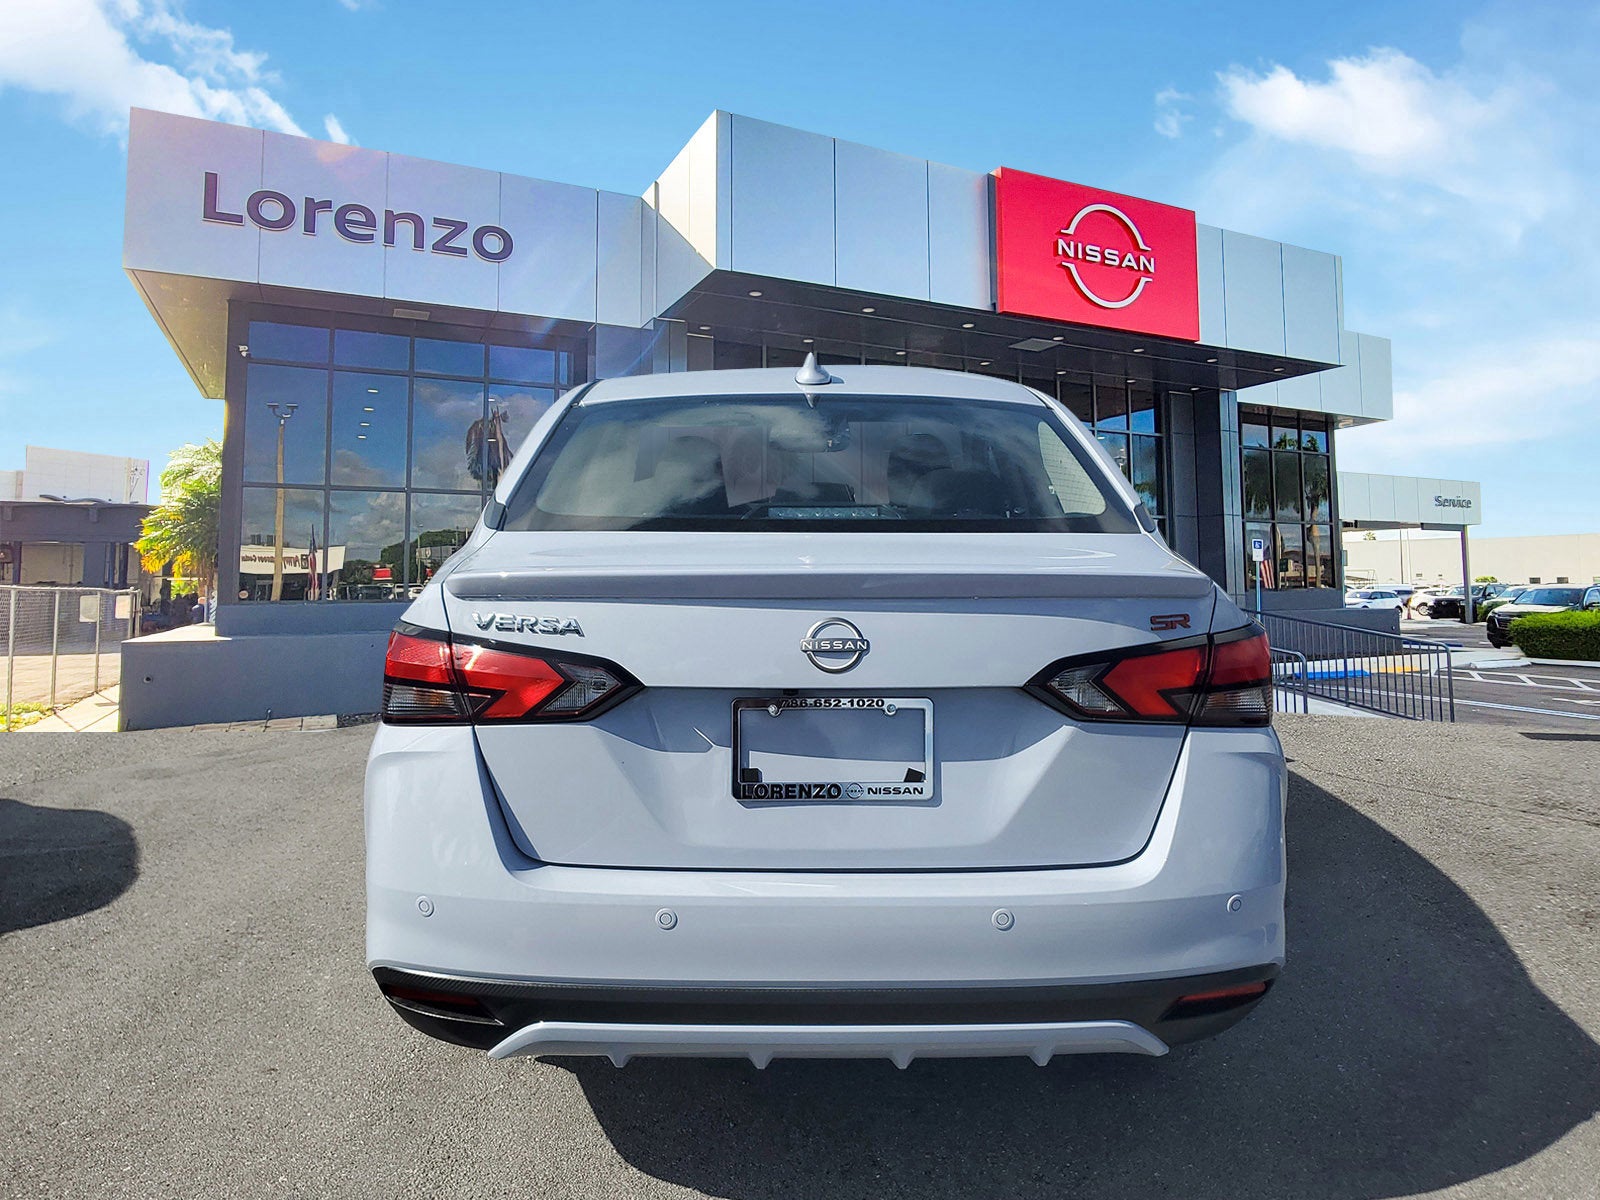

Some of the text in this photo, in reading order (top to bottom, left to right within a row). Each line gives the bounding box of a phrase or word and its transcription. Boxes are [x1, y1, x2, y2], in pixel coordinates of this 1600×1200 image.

[202, 171, 514, 263] Lorenzo
[1057, 238, 1155, 273] NISSAN
[1434, 495, 1472, 508] Service
[471, 612, 585, 637] VERSA
[1150, 613, 1191, 631] SR
[802, 640, 867, 650] NISSAN
[781, 698, 885, 708] 786-652-1020
[741, 782, 924, 800] LORENZO NISSAN
